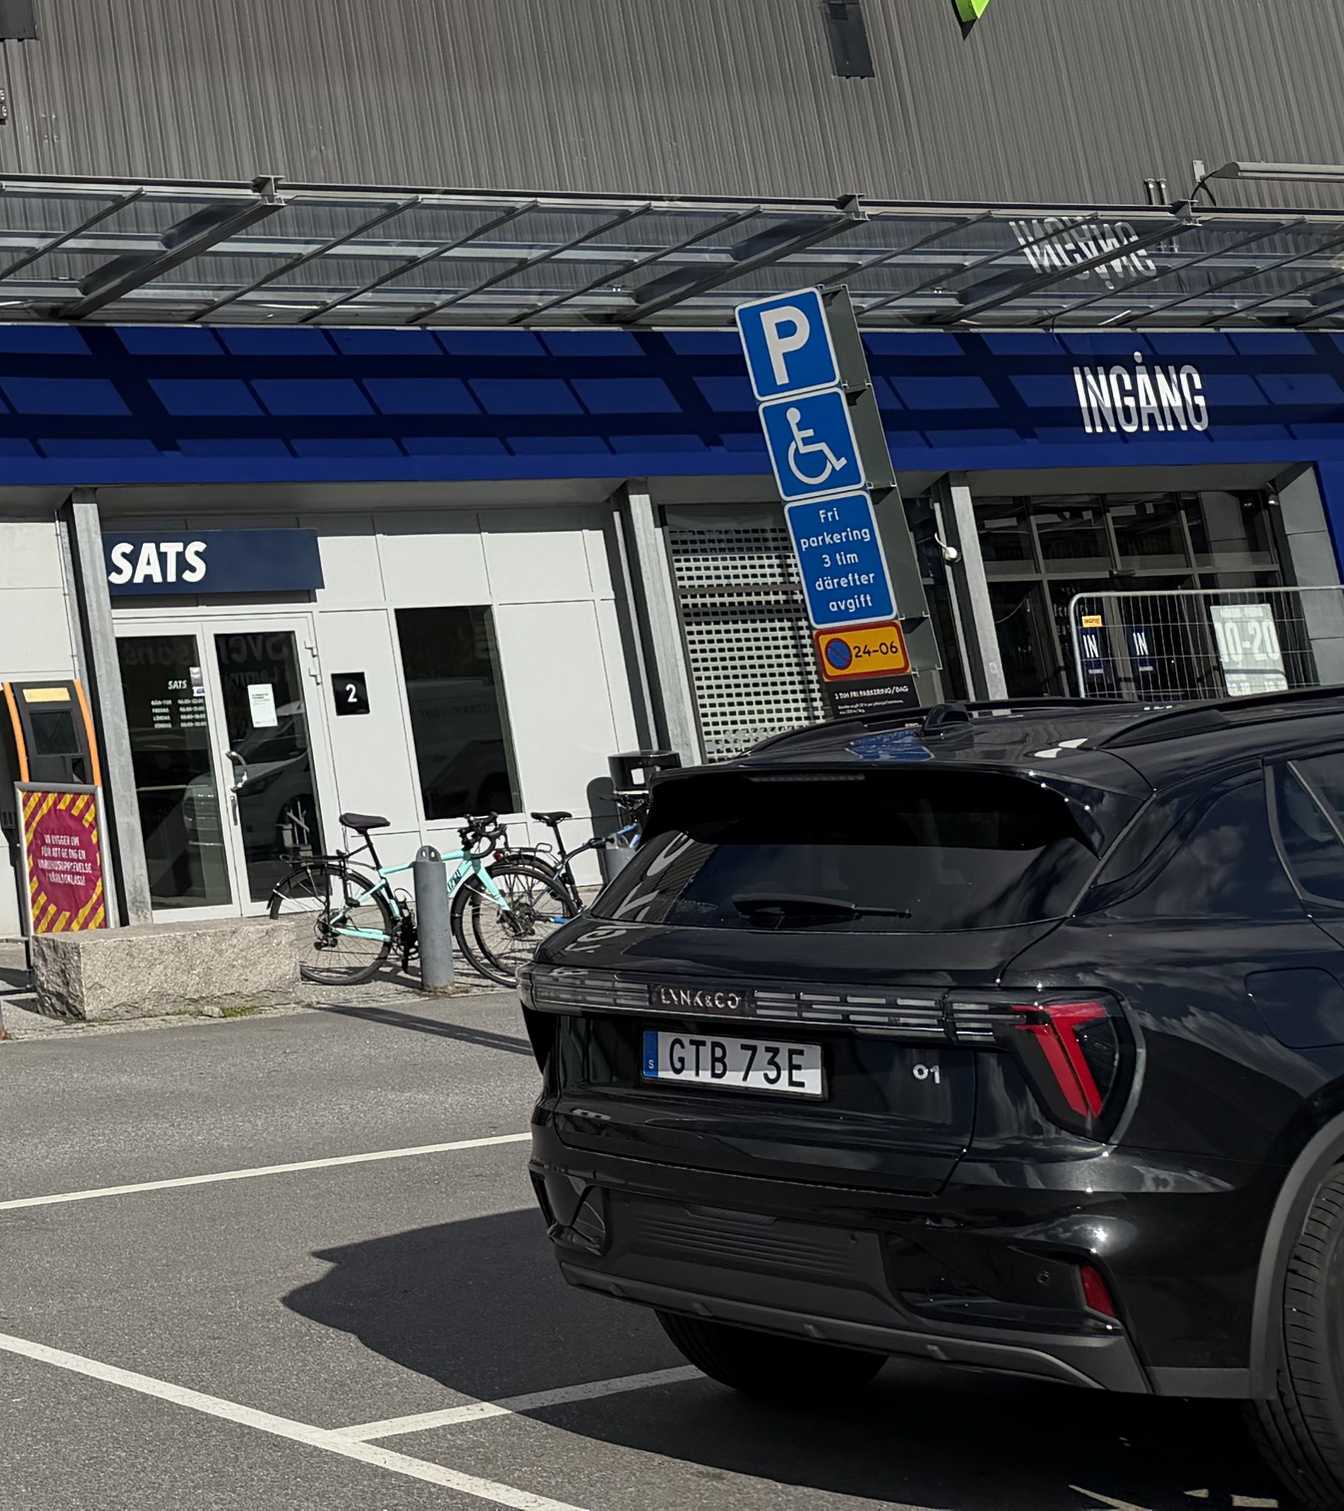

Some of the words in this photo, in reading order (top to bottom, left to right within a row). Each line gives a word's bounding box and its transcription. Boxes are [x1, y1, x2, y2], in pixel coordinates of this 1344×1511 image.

[759, 305, 811, 386] P
[1073, 351, 1209, 434] INGÅNG
[818, 507, 840, 524] Fri
[800, 527, 871, 552] parkering
[107, 540, 208, 585] SATS
[821, 554, 832, 568] 3
[835, 551, 859, 566] tim
[814, 572, 876, 592] därefter
[828, 593, 873, 613] avgift
[852, 640, 899, 659] 24-06
[1214, 620, 1281, 663] 10-20
[167, 679, 188, 691] SATS
[345, 683, 358, 703] 2
[647, 1058, 655, 1070] S
[668, 1037, 729, 1080] GTB
[739, 1043, 806, 1089] 73E
[912, 1063, 941, 1085] 01
